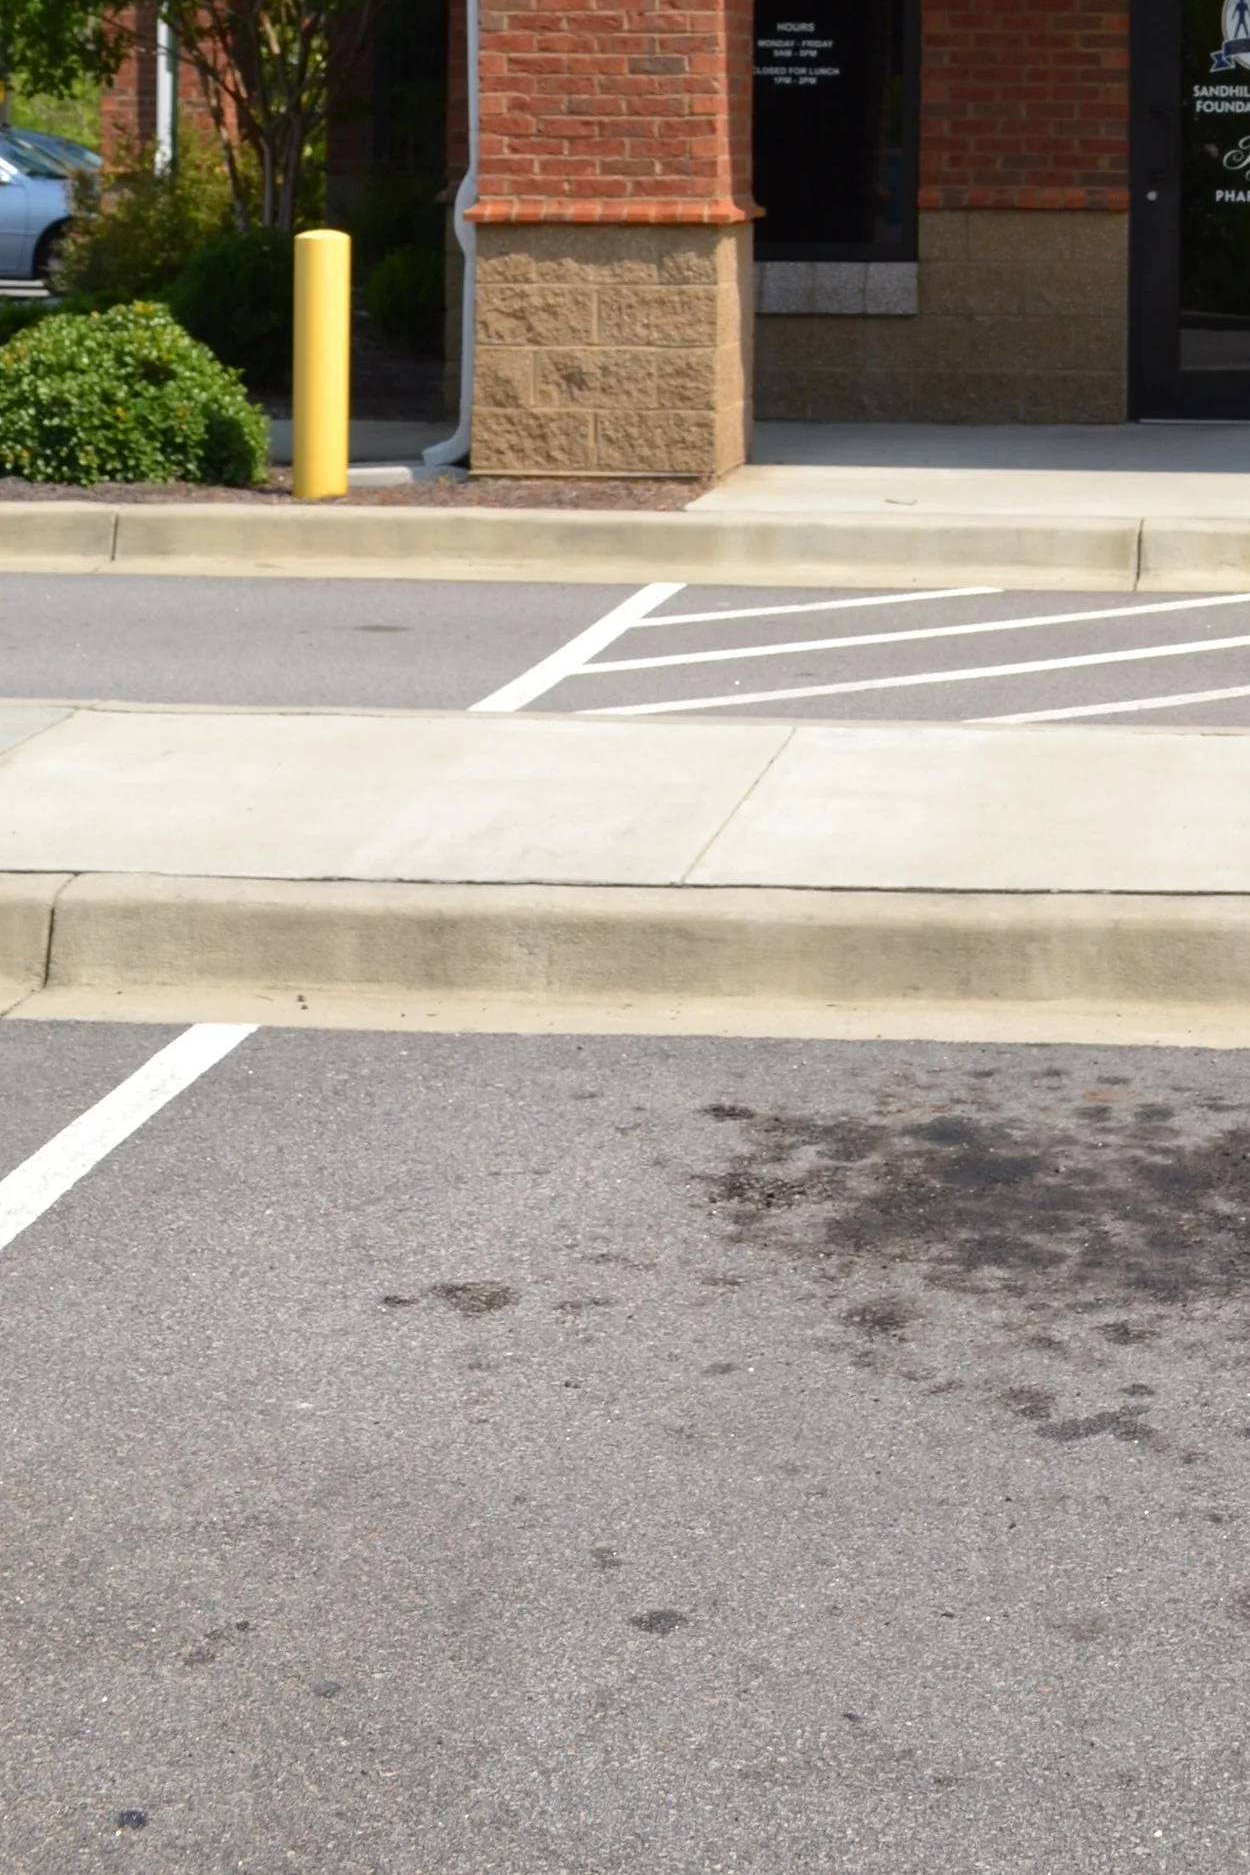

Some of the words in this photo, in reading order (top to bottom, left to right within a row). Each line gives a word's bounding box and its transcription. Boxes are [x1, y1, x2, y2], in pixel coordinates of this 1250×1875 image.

[776, 22, 816, 32] HOURS
[757, 39, 794, 47] MONDAY
[802, 40, 833, 48] FRIDAY
[788, 66, 807, 75] FOR
[809, 67, 840, 76] LUNCH
